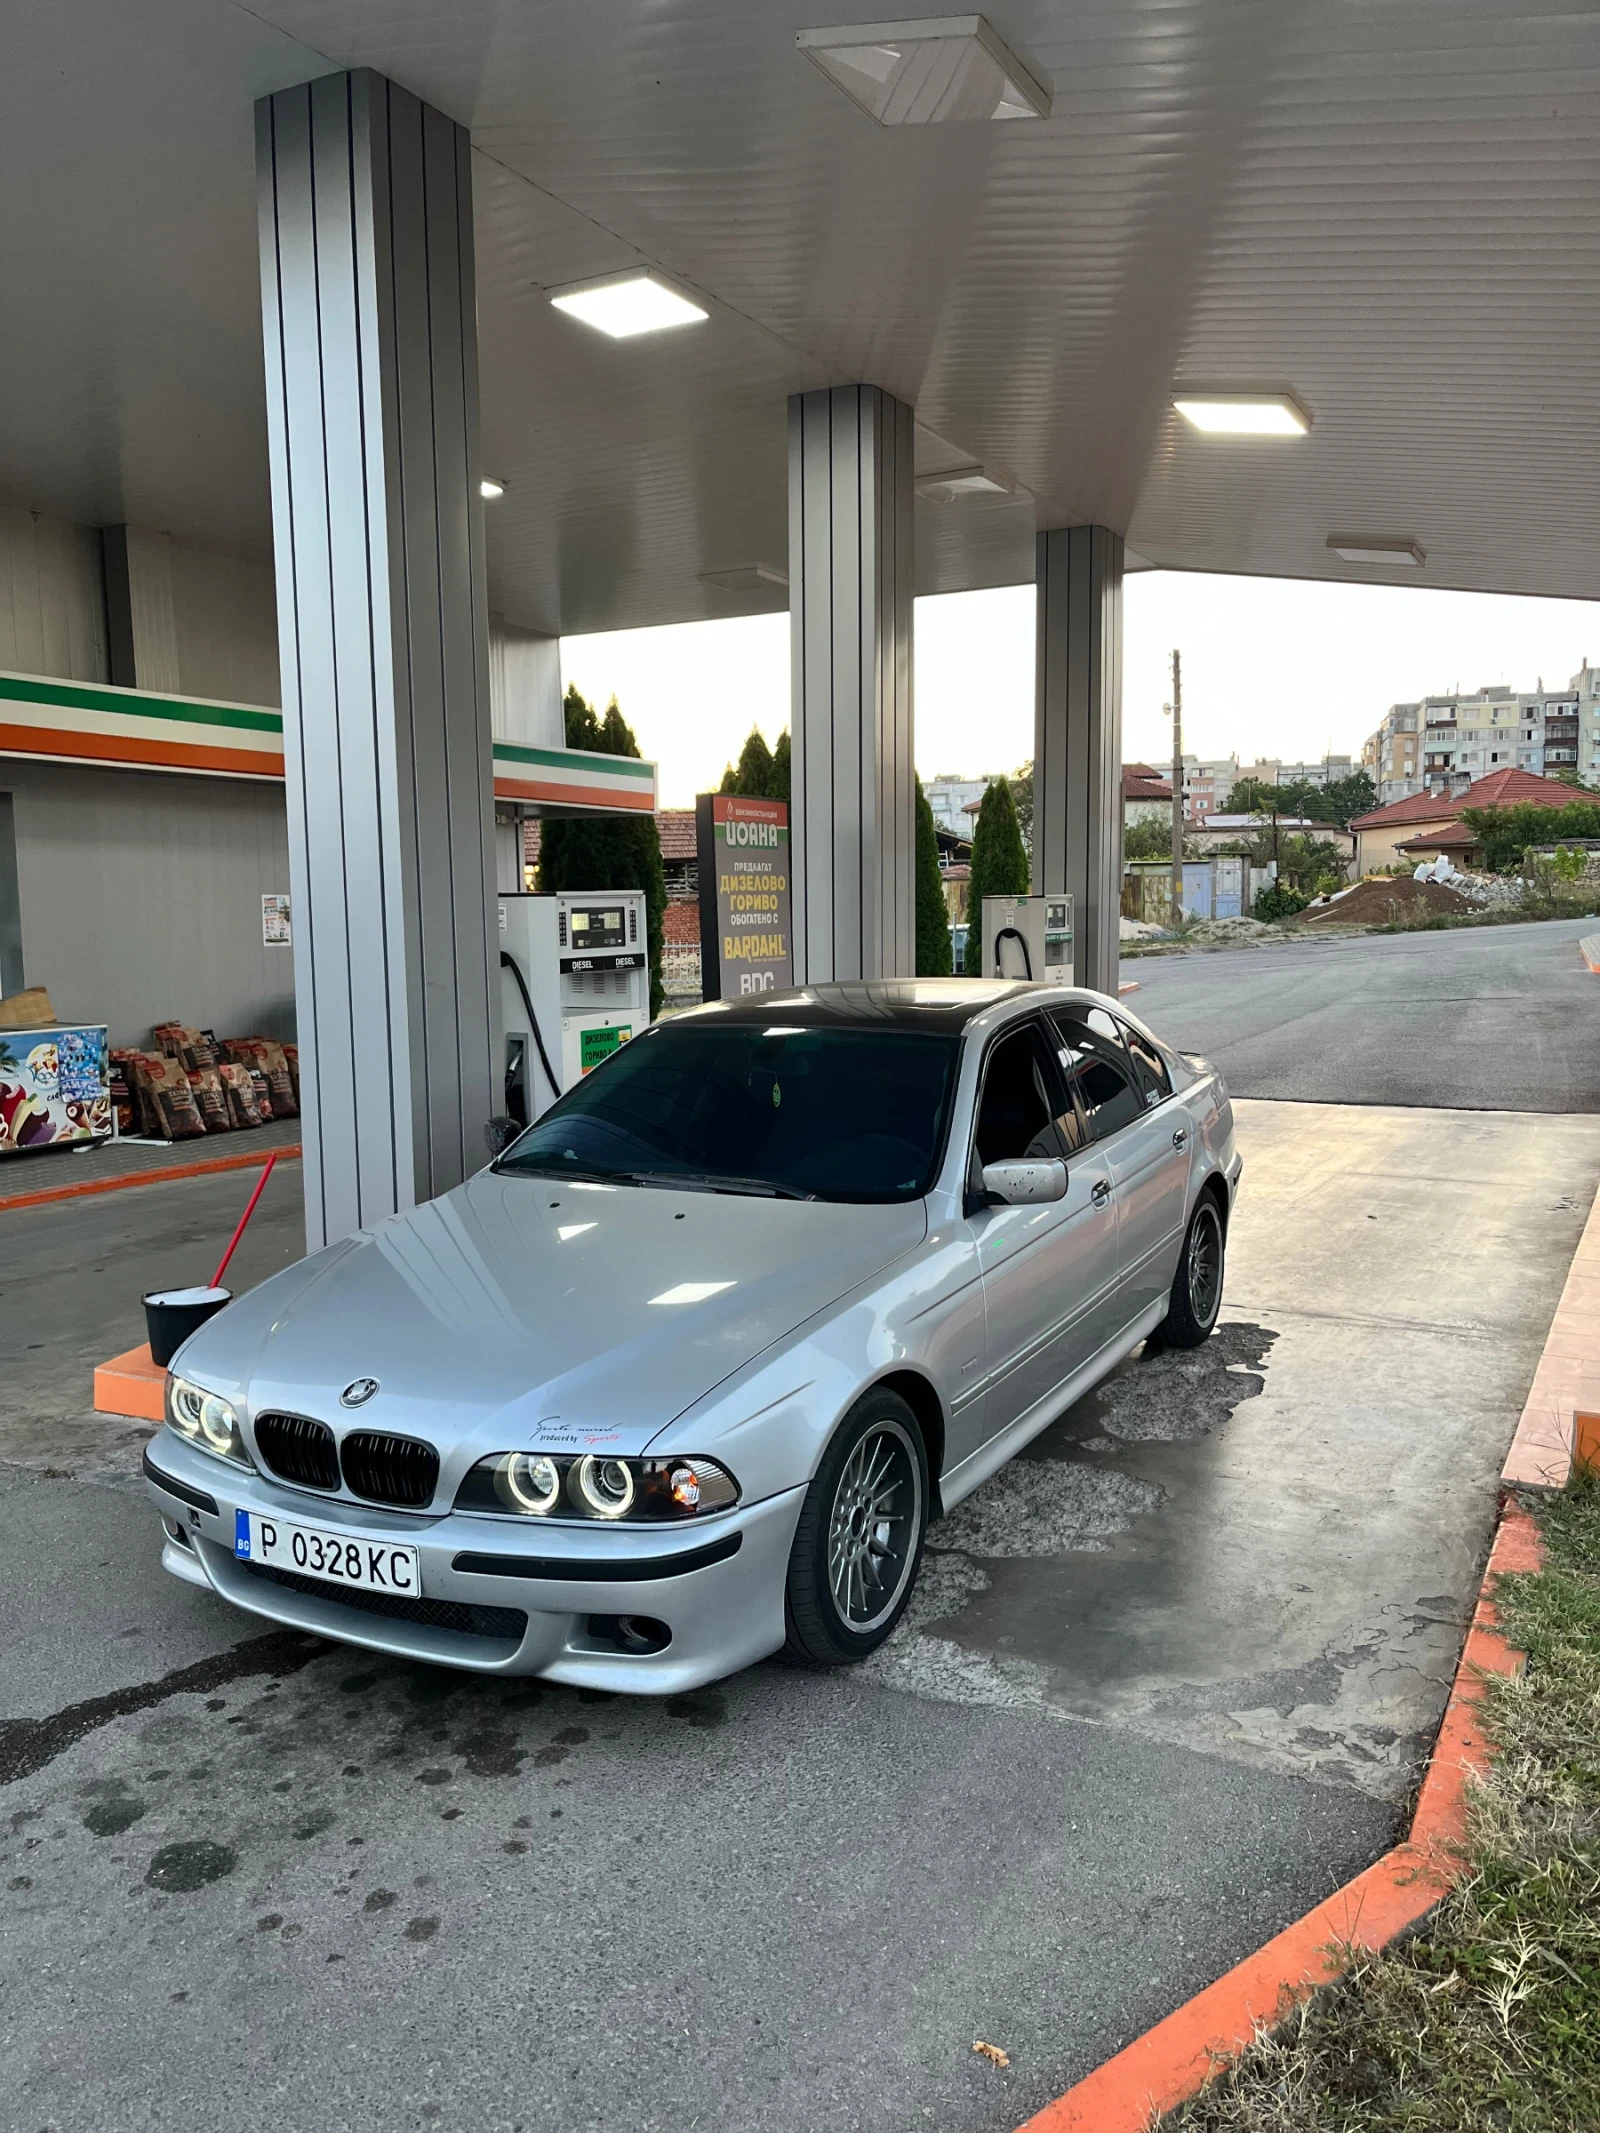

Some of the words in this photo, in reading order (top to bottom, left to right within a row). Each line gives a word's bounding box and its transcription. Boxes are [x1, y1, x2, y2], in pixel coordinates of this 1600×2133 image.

[734, 862, 772, 873] ПРЕДЛАГАТ
[720, 875, 786, 895] ДИЗЕЛОВО
[730, 894, 779, 911] ГОРИВО
[730, 913, 772, 925] ОБОГАТЕНО
[724, 934, 787, 963] BARDAHL
[572, 960, 594, 970] DIESEL
[615, 956, 636, 966] DIESEL
[585, 1032, 615, 1046] ДИЗЕЛОВО
[585, 1049, 607, 1062] ГОРИВО
[540, 1434, 569, 1442] produced
[570, 1434, 578, 1443] by
[583, 1433, 621, 1444] Sports
[237, 1538, 250, 1551] BG
